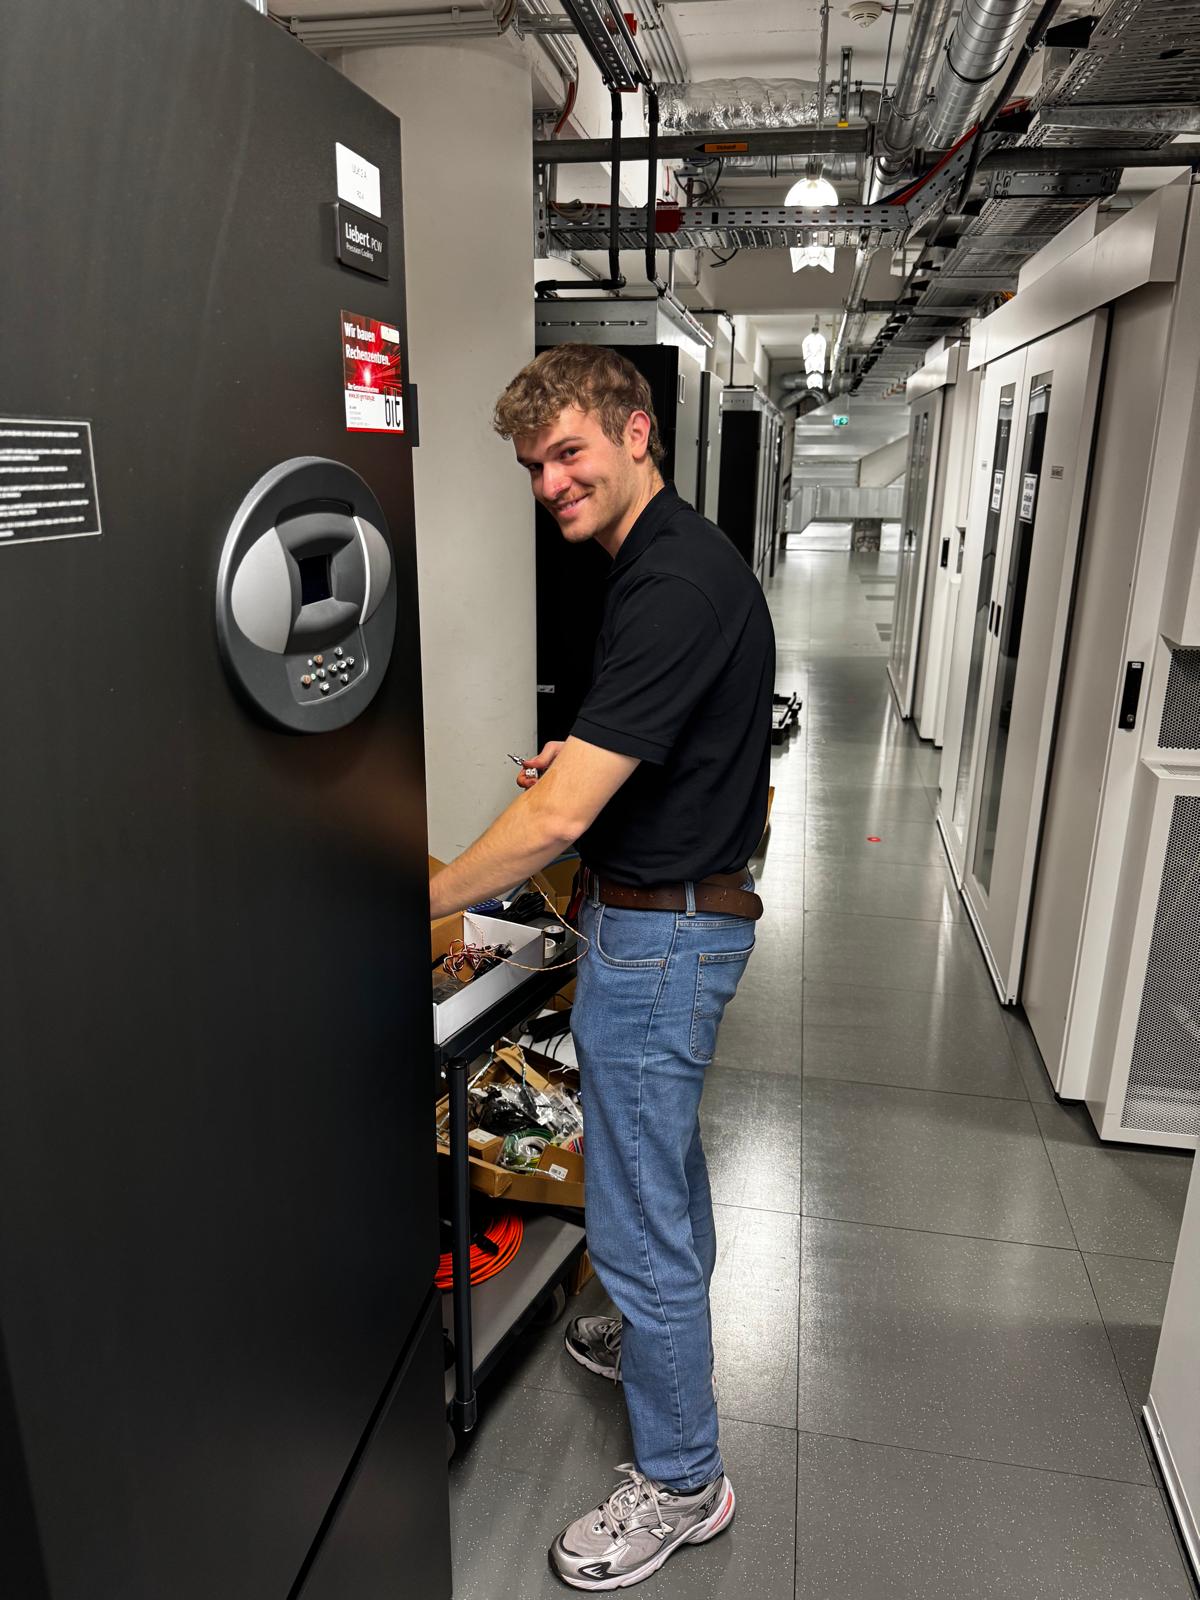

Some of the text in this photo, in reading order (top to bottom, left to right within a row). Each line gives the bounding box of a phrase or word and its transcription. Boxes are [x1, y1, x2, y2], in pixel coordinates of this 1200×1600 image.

[345, 222, 383, 253] Liebert PCW
[344, 321, 376, 343] Wir bauen
[345, 343, 391, 366] Rechenzentren.
